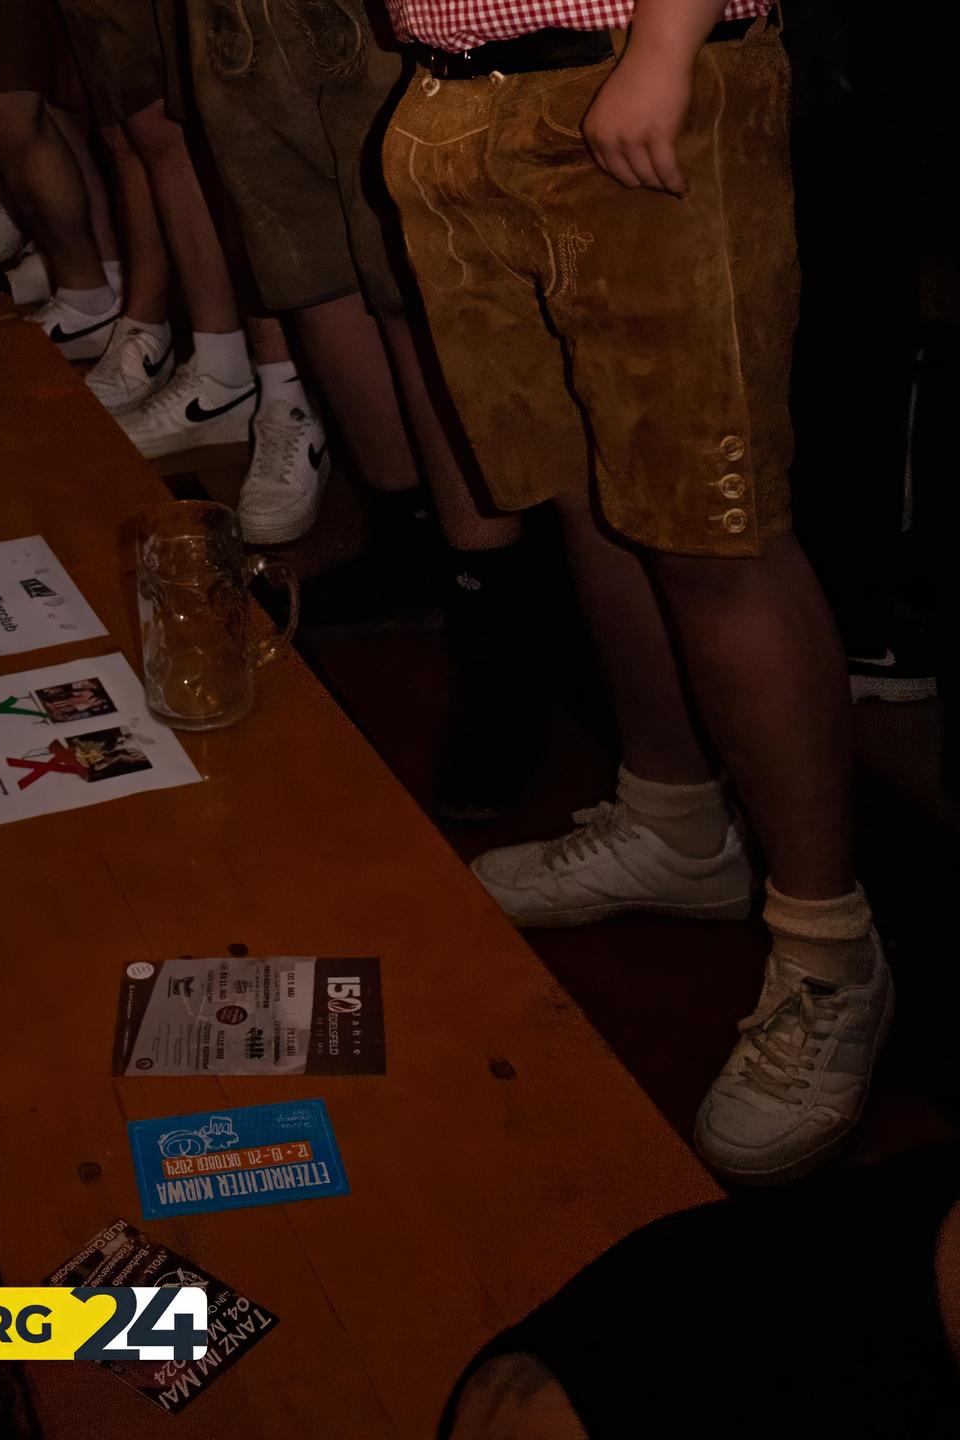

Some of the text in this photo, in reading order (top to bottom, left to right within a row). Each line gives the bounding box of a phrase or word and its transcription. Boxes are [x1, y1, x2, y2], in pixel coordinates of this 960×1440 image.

[329, 1013, 338, 1056] EDELSFELD
[166, 1159, 192, 1175] 2024
[197, 1152, 241, 1170] OKTOBER
[156, 1162, 330, 1204] ETZENRICHTER KIRWA
[218, 1307, 271, 1356] TANZ
[195, 1348, 223, 1376] IM
[157, 1367, 202, 1410] MAI
